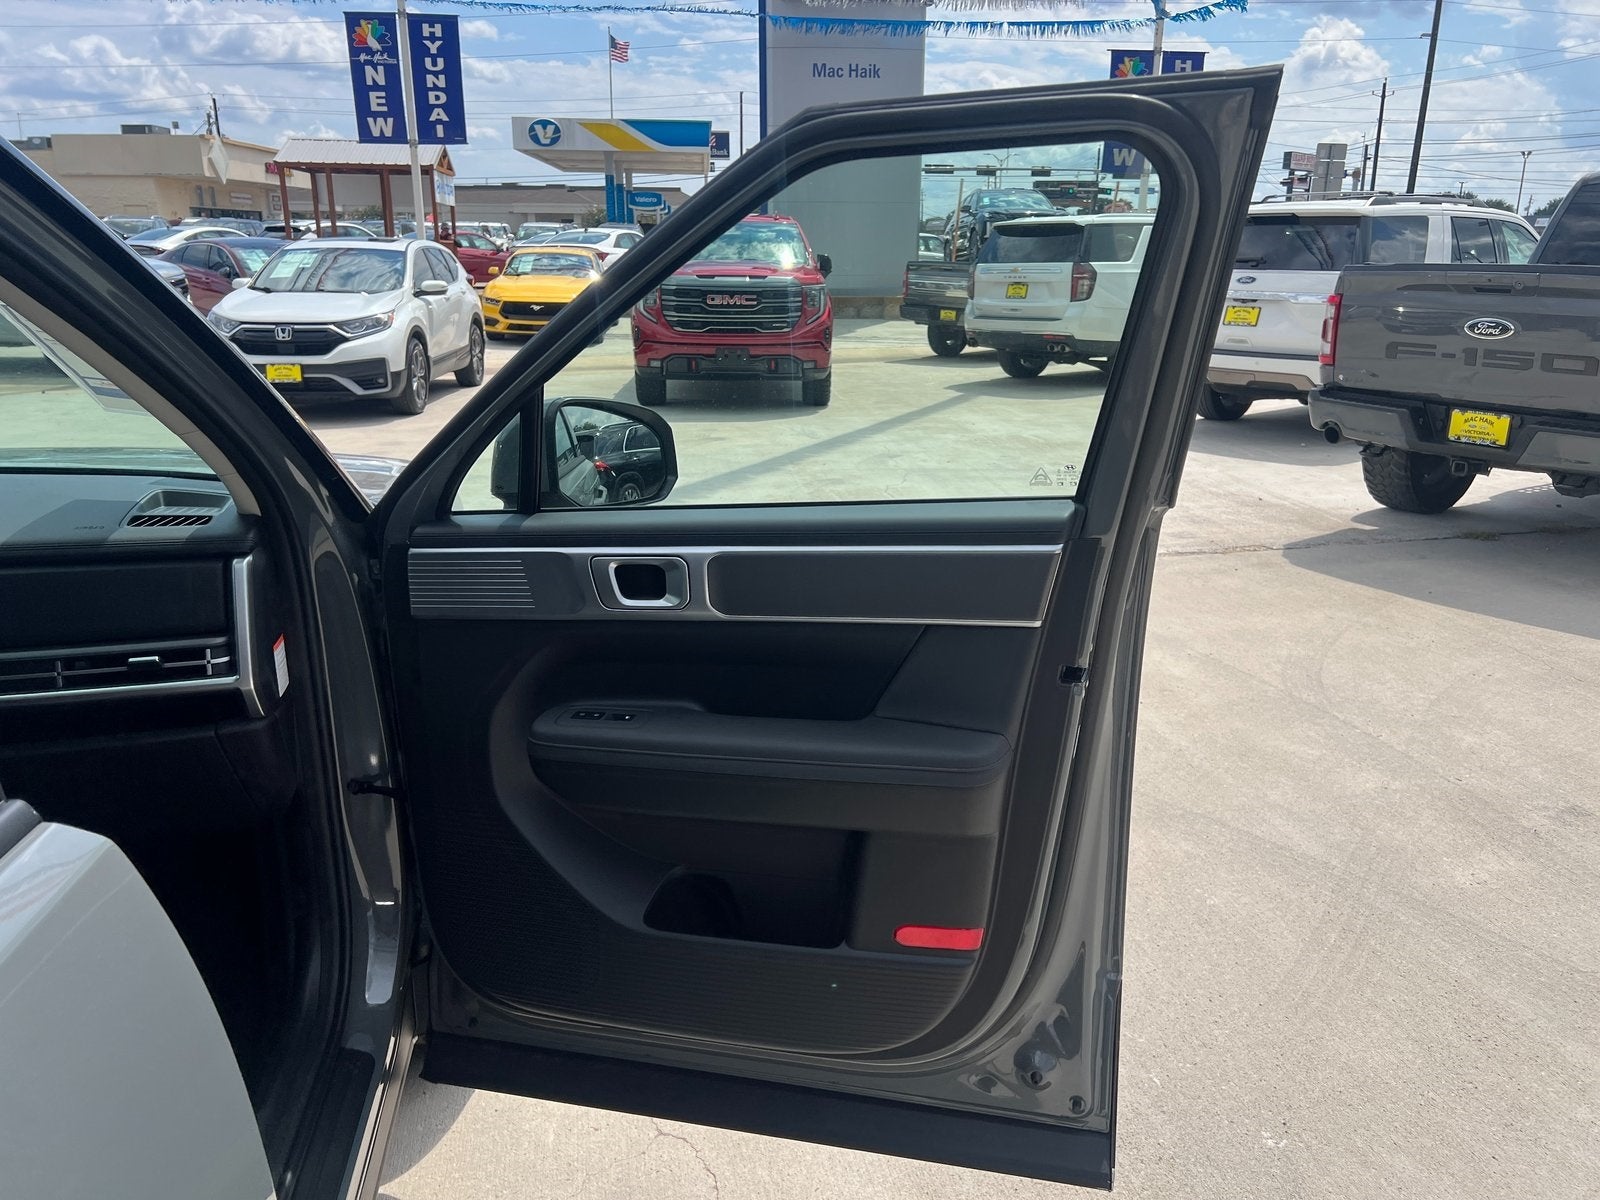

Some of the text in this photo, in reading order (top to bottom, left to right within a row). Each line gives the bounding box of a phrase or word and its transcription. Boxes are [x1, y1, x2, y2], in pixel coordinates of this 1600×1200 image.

[812, 62, 881, 79] Mac Haik
[421, 23, 450, 138] HYUNDAI
[364, 65, 394, 138] NEW
[706, 294, 758, 305] GMC
[1474, 321, 1503, 336] Ford
[1385, 341, 1600, 376] F-150
[1464, 416, 1495, 426] MAC HAIK
